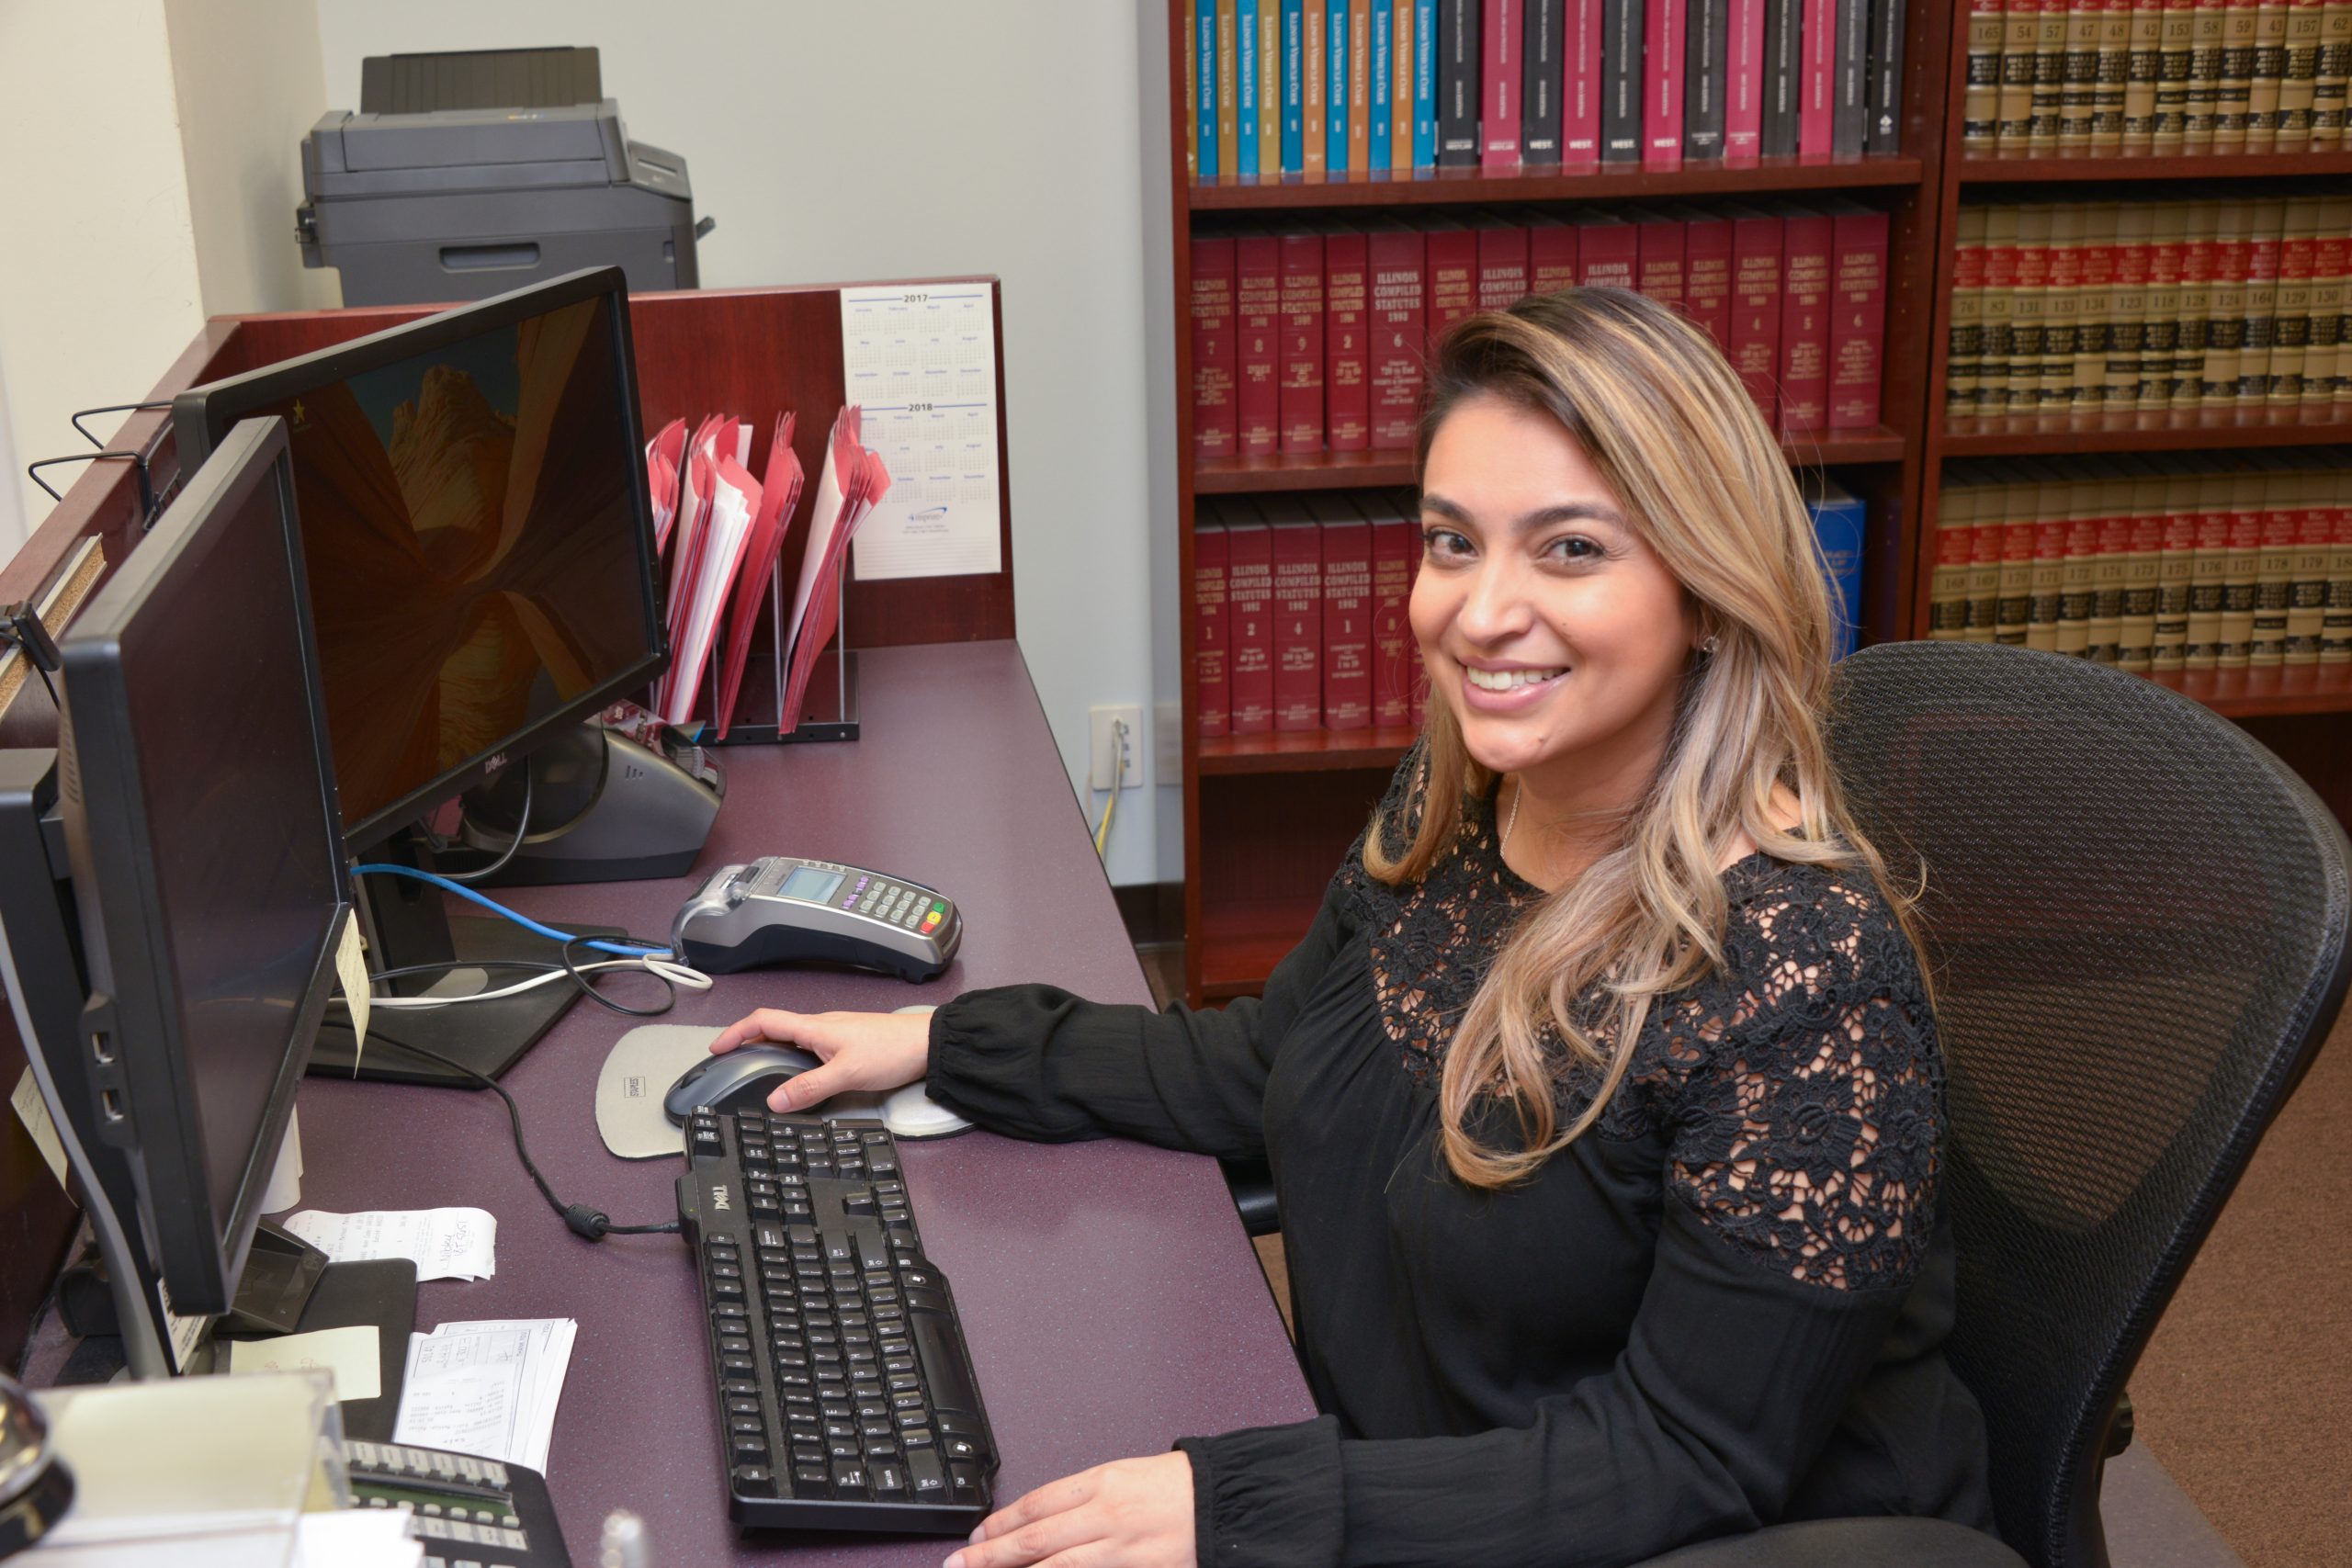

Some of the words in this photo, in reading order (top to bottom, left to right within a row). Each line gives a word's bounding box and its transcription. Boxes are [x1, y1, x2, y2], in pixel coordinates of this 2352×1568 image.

[2205, 22, 2218, 33] 58
[2236, 21, 2250, 33] 59
[2268, 20, 2282, 31] 43
[2297, 20, 2317, 32] 157
[2333, 18, 2347, 29] 62
[1977, 28, 1999, 39] 165
[2017, 27, 2031, 39] 54
[2046, 26, 2061, 38] 57
[2080, 25, 2094, 37] 47
[2109, 25, 2124, 37] 48
[2143, 24, 2157, 36] 42
[2170, 24, 2190, 36] 153
[1483, 268, 1523, 279] ILLINOIS
[1588, 263, 1629, 276] ILLINOIS
[1377, 271, 1419, 284] ILLINOIS
[1374, 285, 1421, 298] COMPILED
[1479, 281, 1526, 293] COMPILED
[904, 295, 928, 303] 2017
[2285, 292, 2306, 303] 129
[2317, 290, 2338, 302] 130
[1375, 298, 1420, 310] STATUTES
[2120, 297, 2141, 309] 123
[1298, 337, 1306, 351] 9
[1343, 335, 1352, 349] 2
[1394, 334, 1402, 347] 6
[1328, 562, 1367, 573] ILLINOIS
[2267, 558, 2288, 569] 178
[2301, 557, 2323, 568] 179
[1232, 564, 1270, 577] ILLINOIS
[1277, 564, 1317, 575] ILLINOIS
[1230, 577, 1272, 589] COMPILED
[1274, 575, 1320, 587] COMPILED
[1325, 574, 1371, 586] COMPILED
[1231, 589, 1272, 602] STATUTES
[1276, 588, 1319, 600] STATUTES
[1326, 586, 1370, 598] STATUTES
[1247, 623, 1255, 636] 2
[1345, 620, 1351, 633] 1
[485, 752, 507, 774] DELL
[713, 1185, 730, 1211] DELL
